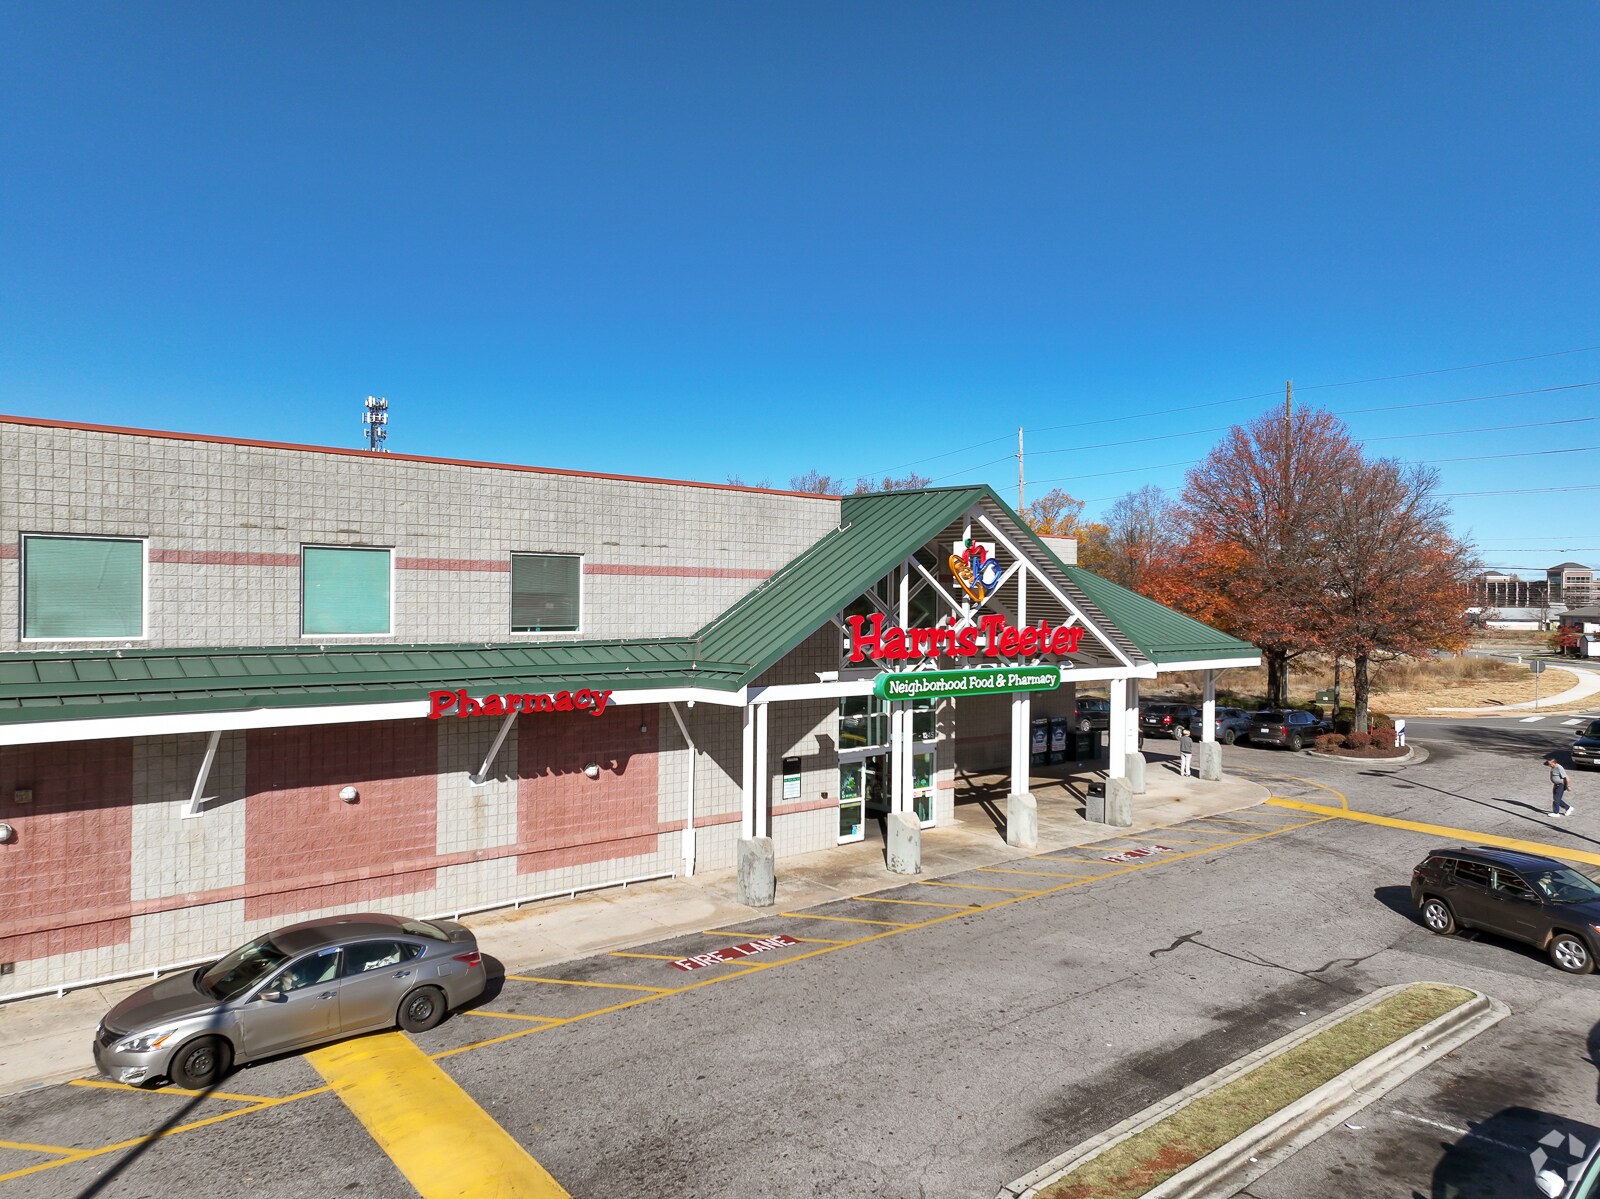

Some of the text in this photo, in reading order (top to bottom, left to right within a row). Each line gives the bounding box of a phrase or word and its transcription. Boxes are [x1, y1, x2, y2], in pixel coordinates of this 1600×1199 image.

[846, 613, 1084, 662] Harris Teeter
[889, 673, 1056, 696] Neighborhood Food & Pharmacy
[428, 689, 612, 719] Pharmacy
[675, 935, 796, 971] FIRE LANE
